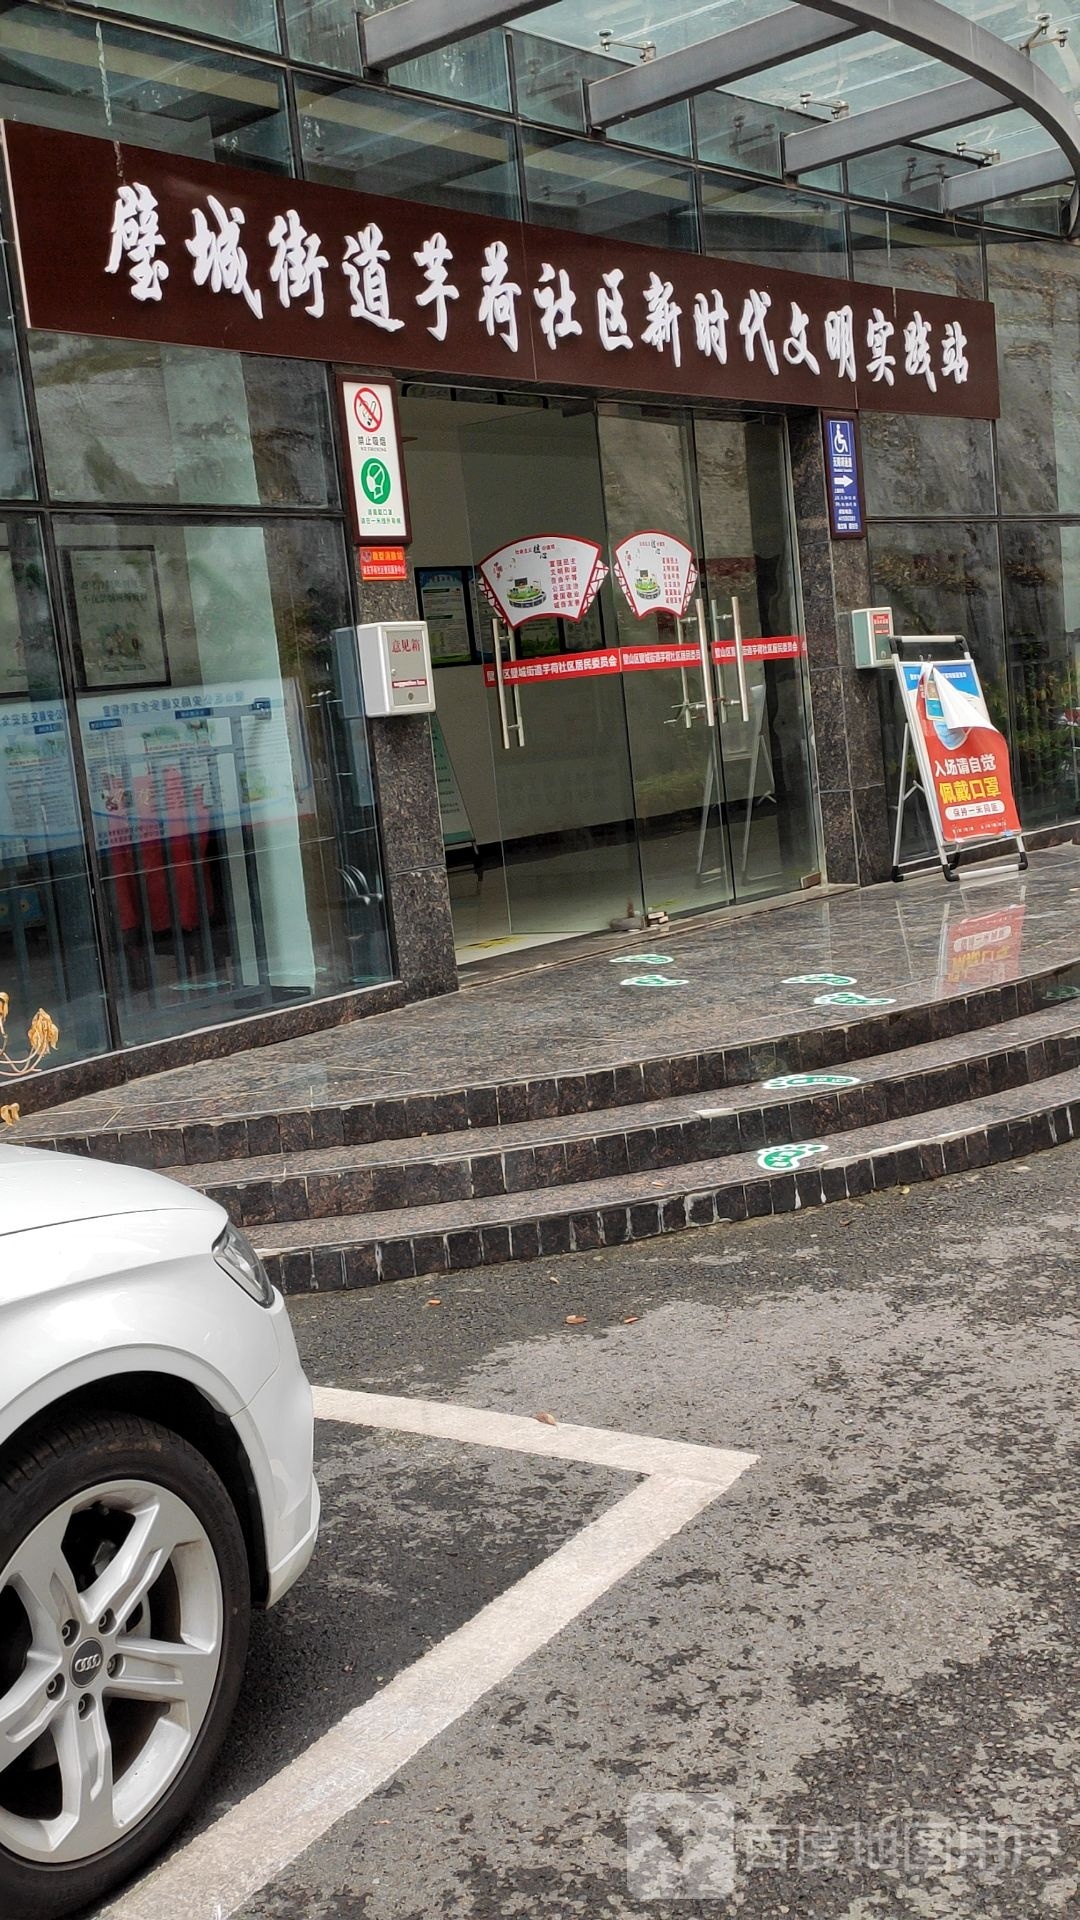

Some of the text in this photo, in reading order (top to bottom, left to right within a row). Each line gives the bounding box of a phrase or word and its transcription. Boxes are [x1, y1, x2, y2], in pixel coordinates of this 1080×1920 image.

[104, 182, 970, 393] 璧城街道芋荷社区新时代文明实践站
[391, 639, 421, 653] 意见箱
[934, 753, 997, 777] 入场请自觉
[939, 776, 1001, 805] 佩戴口罩
